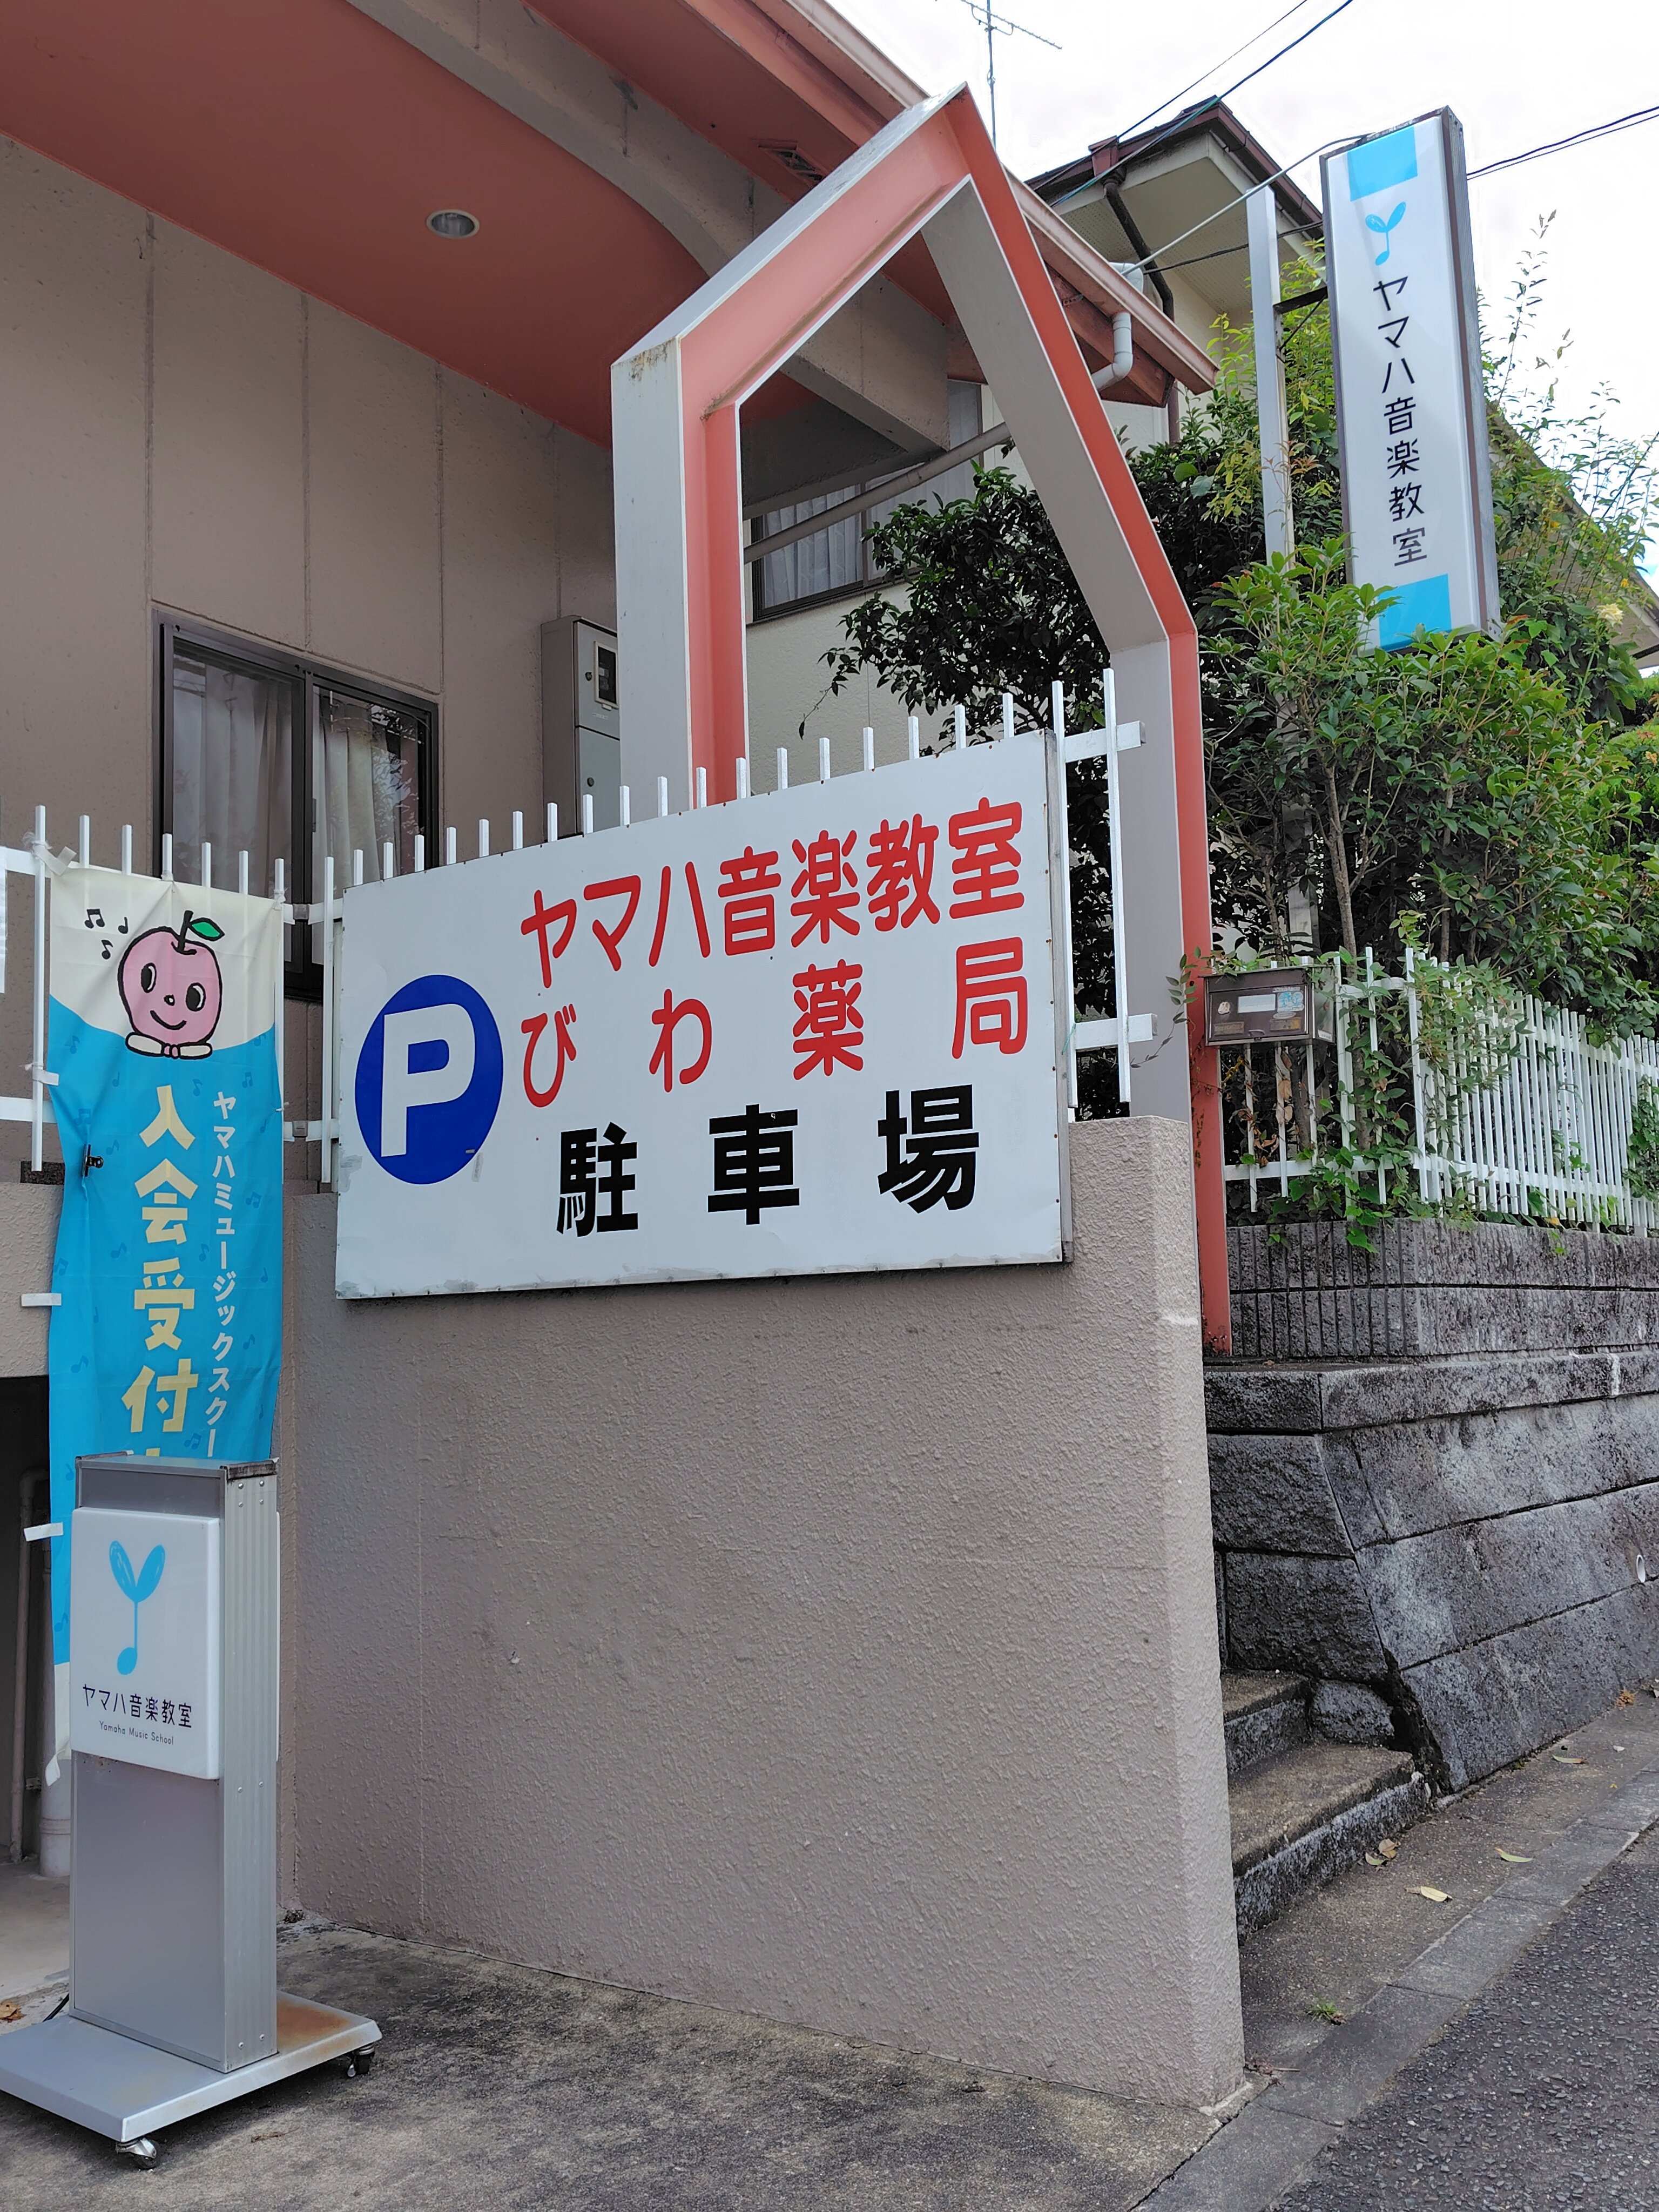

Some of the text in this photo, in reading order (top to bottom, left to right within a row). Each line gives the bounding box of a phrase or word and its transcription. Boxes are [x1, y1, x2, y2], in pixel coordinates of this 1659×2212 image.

[1373, 276, 1427, 567] ヤマハ音楽教室
[521, 797, 1025, 989] ヤマハ音楽教室
[381, 1003, 475, 1157] P
[556, 1084, 979, 1237] 駐車場
[122, 1085, 199, 1456] 入会受付
[83, 1684, 192, 1728] ヤマハ音楽教室
[99, 1721, 174, 1745] Yamaha Music School
